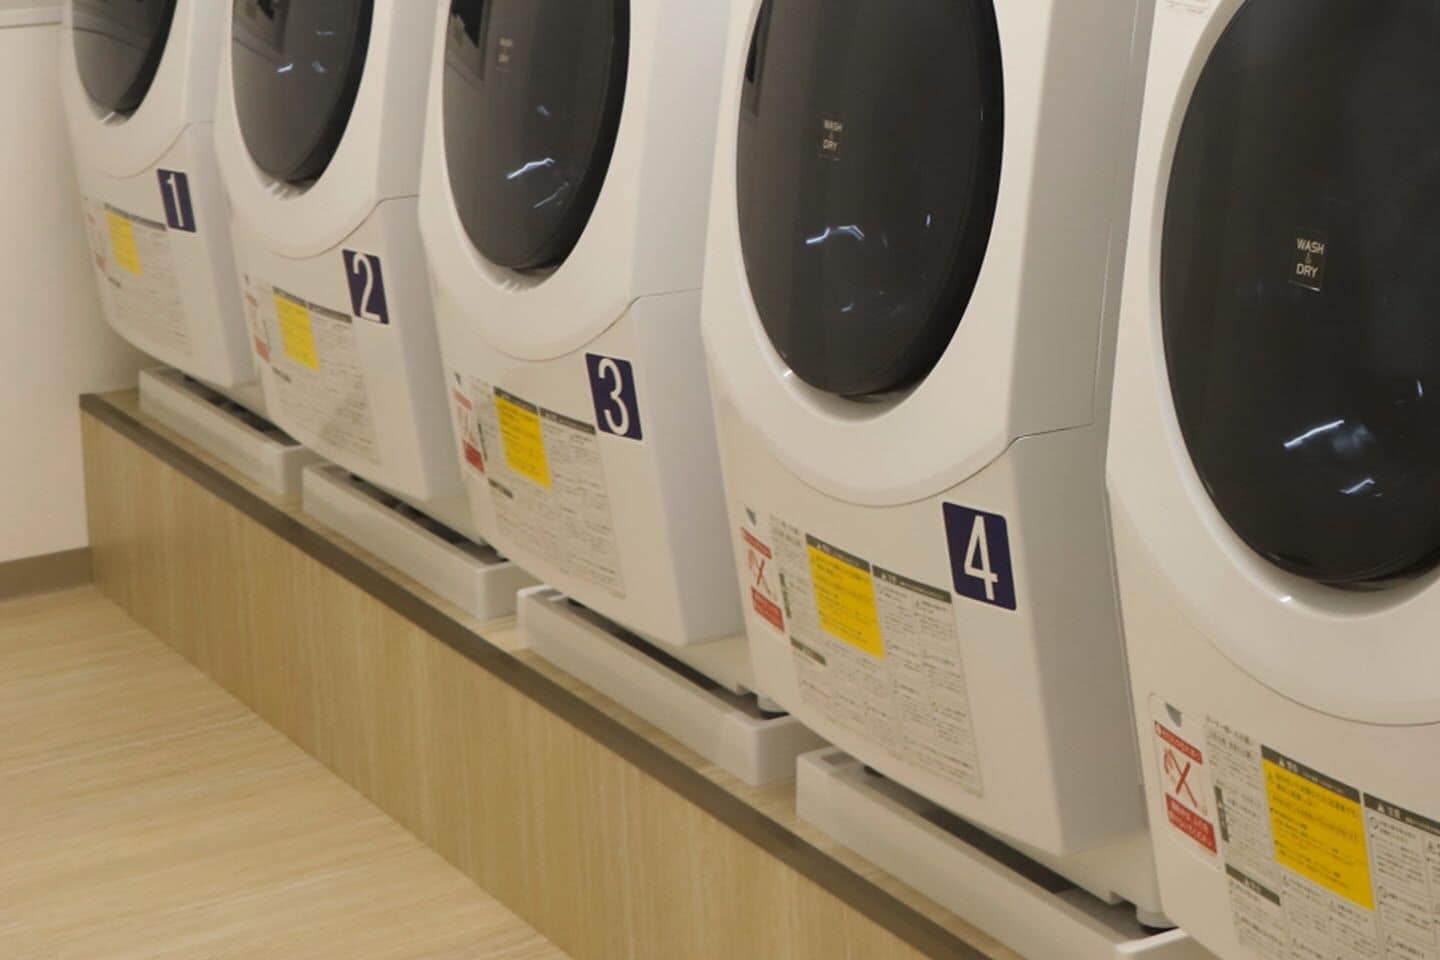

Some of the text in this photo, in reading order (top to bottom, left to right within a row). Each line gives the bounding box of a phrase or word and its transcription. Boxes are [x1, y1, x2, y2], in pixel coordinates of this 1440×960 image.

[167, 172, 185, 228] 1
[1296, 263, 1319, 278] DRY
[1297, 238, 1325, 255] WASH
[353, 251, 382, 323] 2
[598, 358, 630, 436] 3
[963, 514, 998, 601] 4
